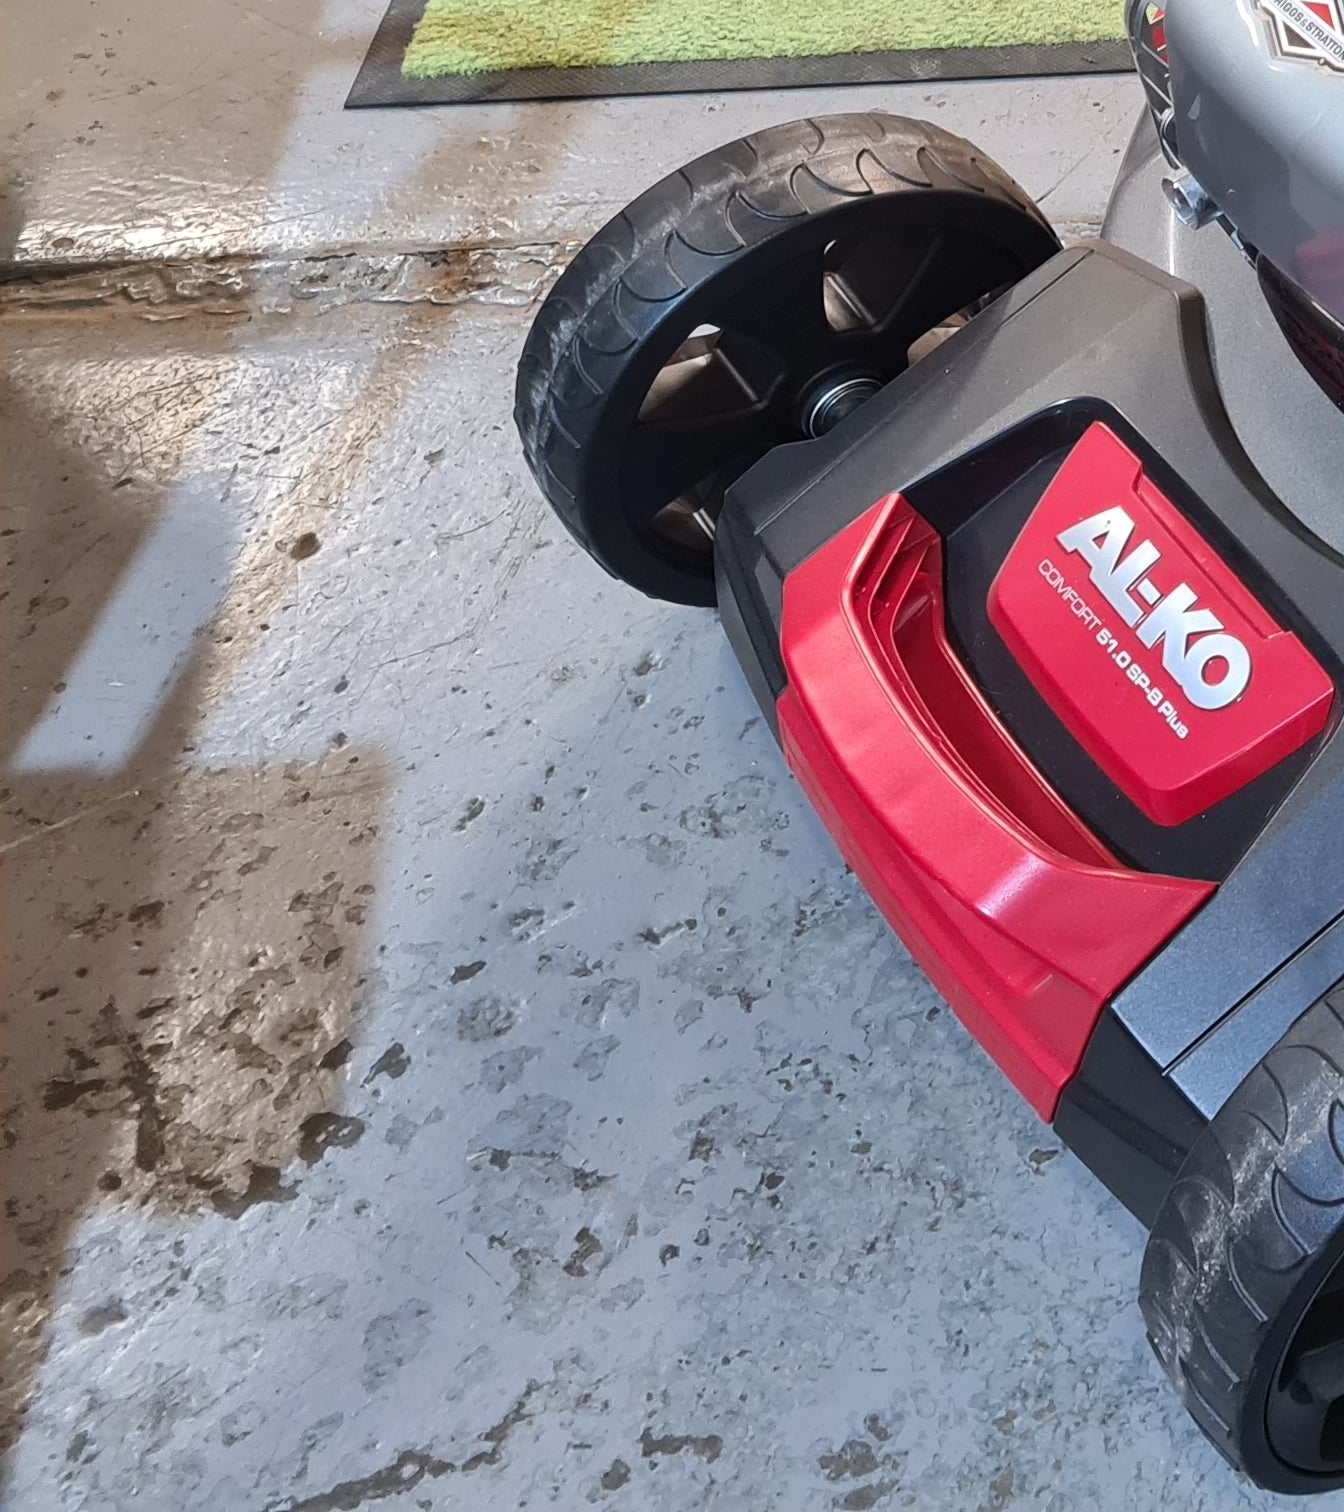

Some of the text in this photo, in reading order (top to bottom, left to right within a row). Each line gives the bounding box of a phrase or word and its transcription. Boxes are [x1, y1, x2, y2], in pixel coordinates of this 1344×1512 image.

[1037, 558, 1103, 631] COMFORT
[1095, 626, 1132, 670] 51.0
[1157, 699, 1190, 740] Plus
[1056, 504, 1253, 711] AL-KO
